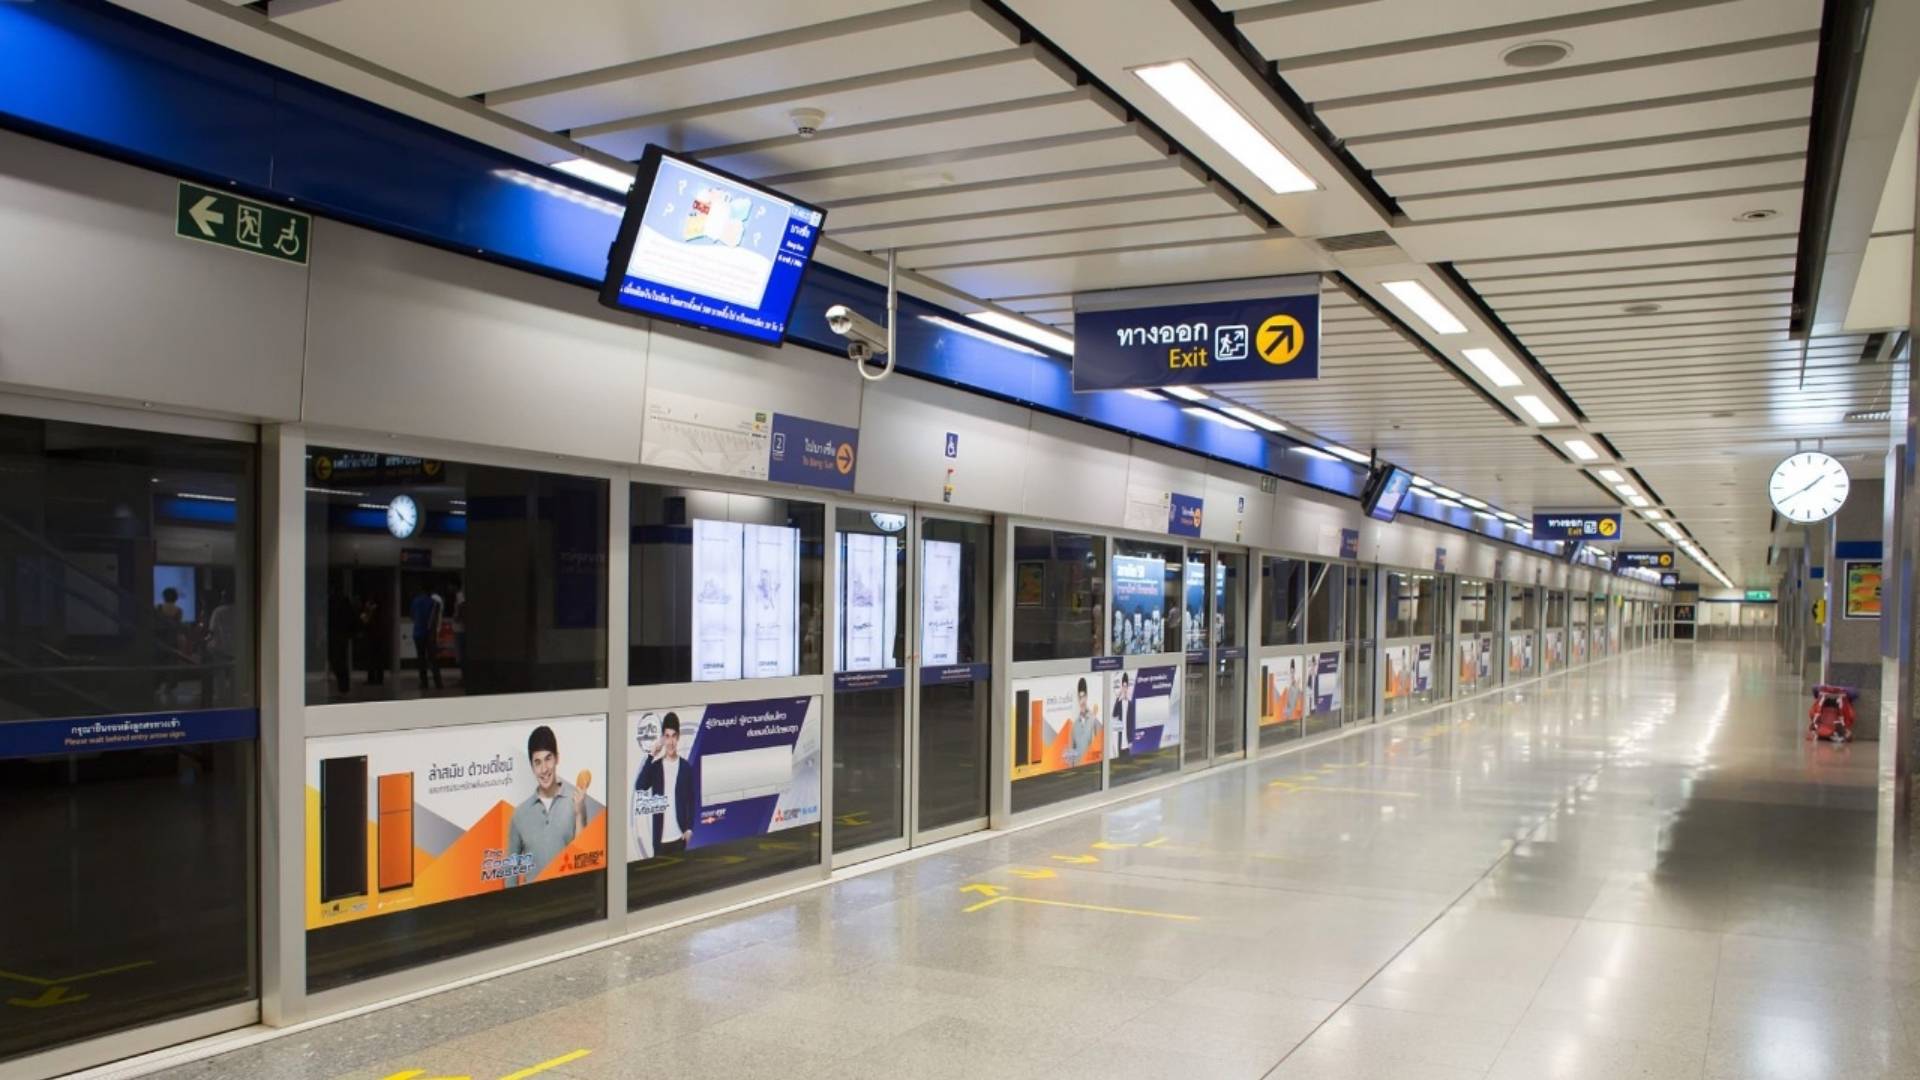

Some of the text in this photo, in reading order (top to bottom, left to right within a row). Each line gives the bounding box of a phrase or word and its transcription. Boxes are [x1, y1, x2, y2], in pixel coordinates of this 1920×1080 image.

[1117, 323, 1208, 346] ทางออก
[1169, 347, 1208, 368] Exit
[776, 438, 782, 449] 2
[481, 863, 536, 880] Master
